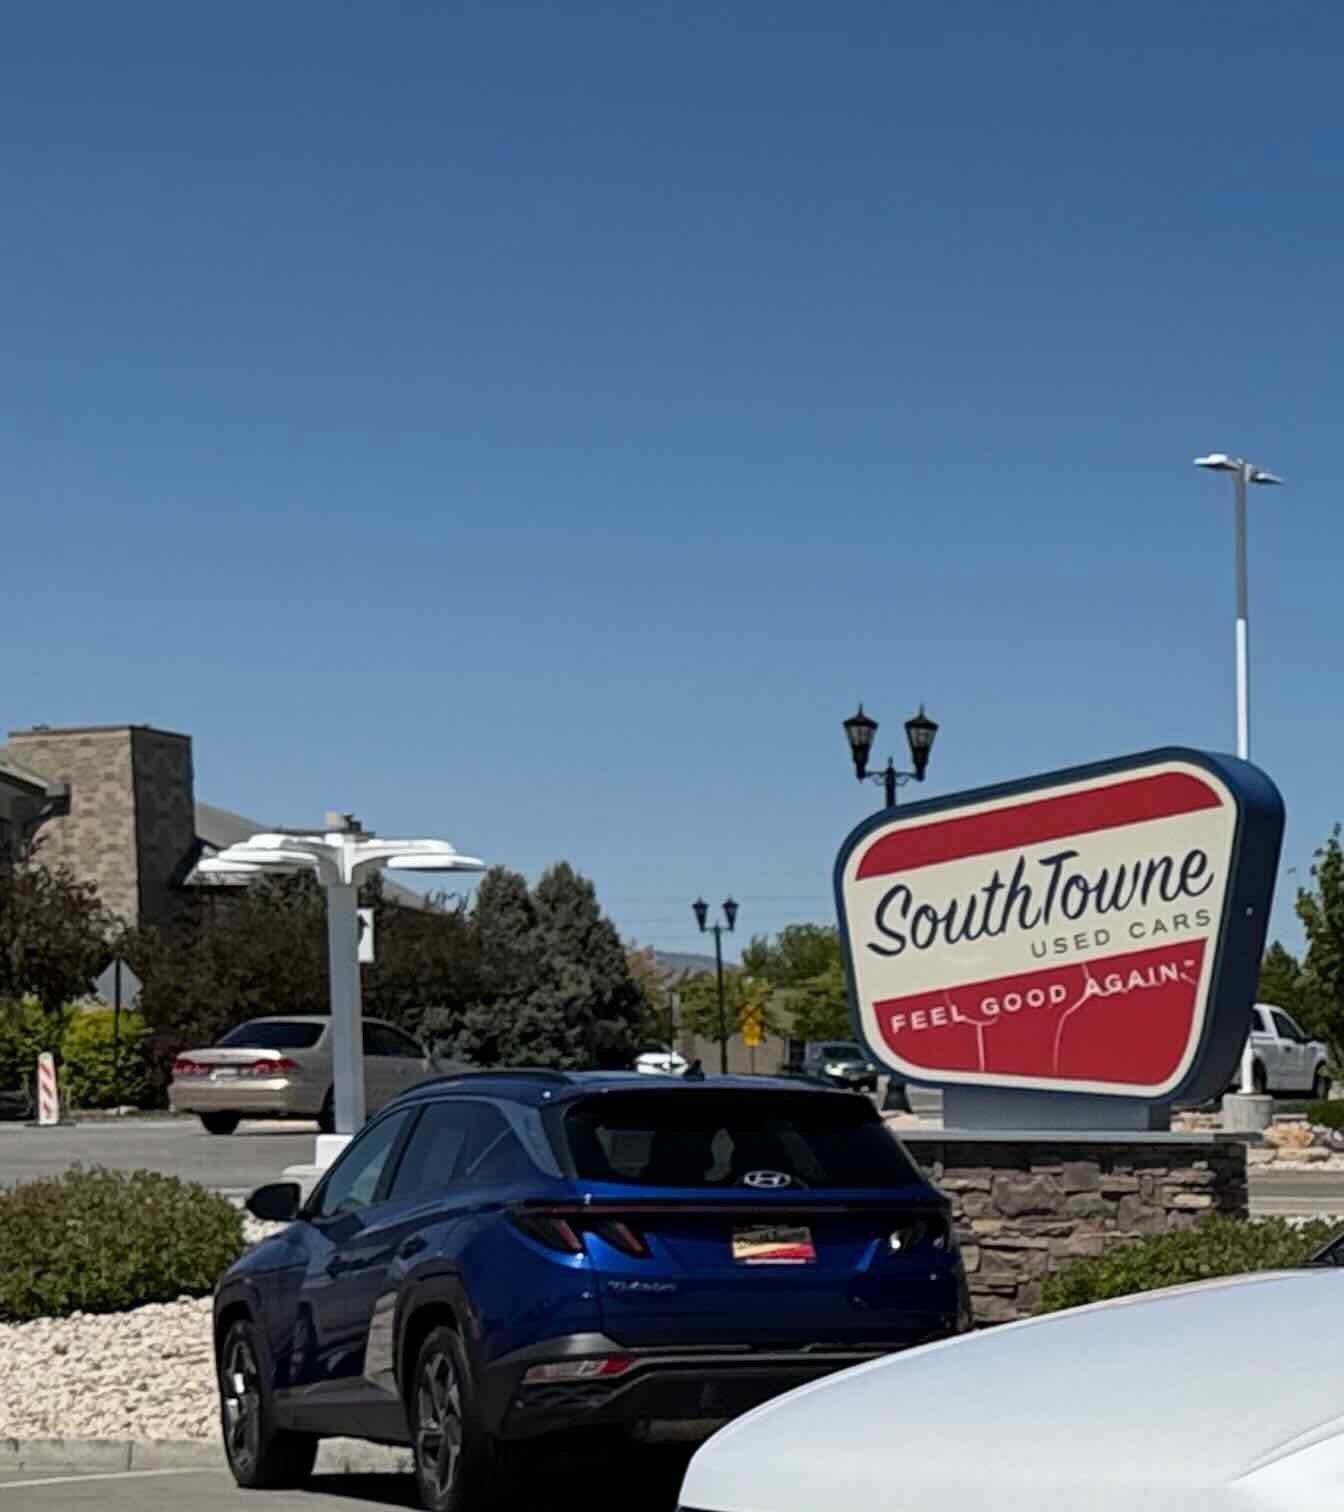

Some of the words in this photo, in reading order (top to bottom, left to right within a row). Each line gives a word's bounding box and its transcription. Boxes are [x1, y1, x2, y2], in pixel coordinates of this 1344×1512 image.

[866, 849, 1214, 957] SouthTowne
[1031, 929, 1111, 958] USED
[1128, 909, 1211, 939] CARS
[890, 1004, 966, 1034] FEEL
[980, 984, 1067, 1016] GOOD
